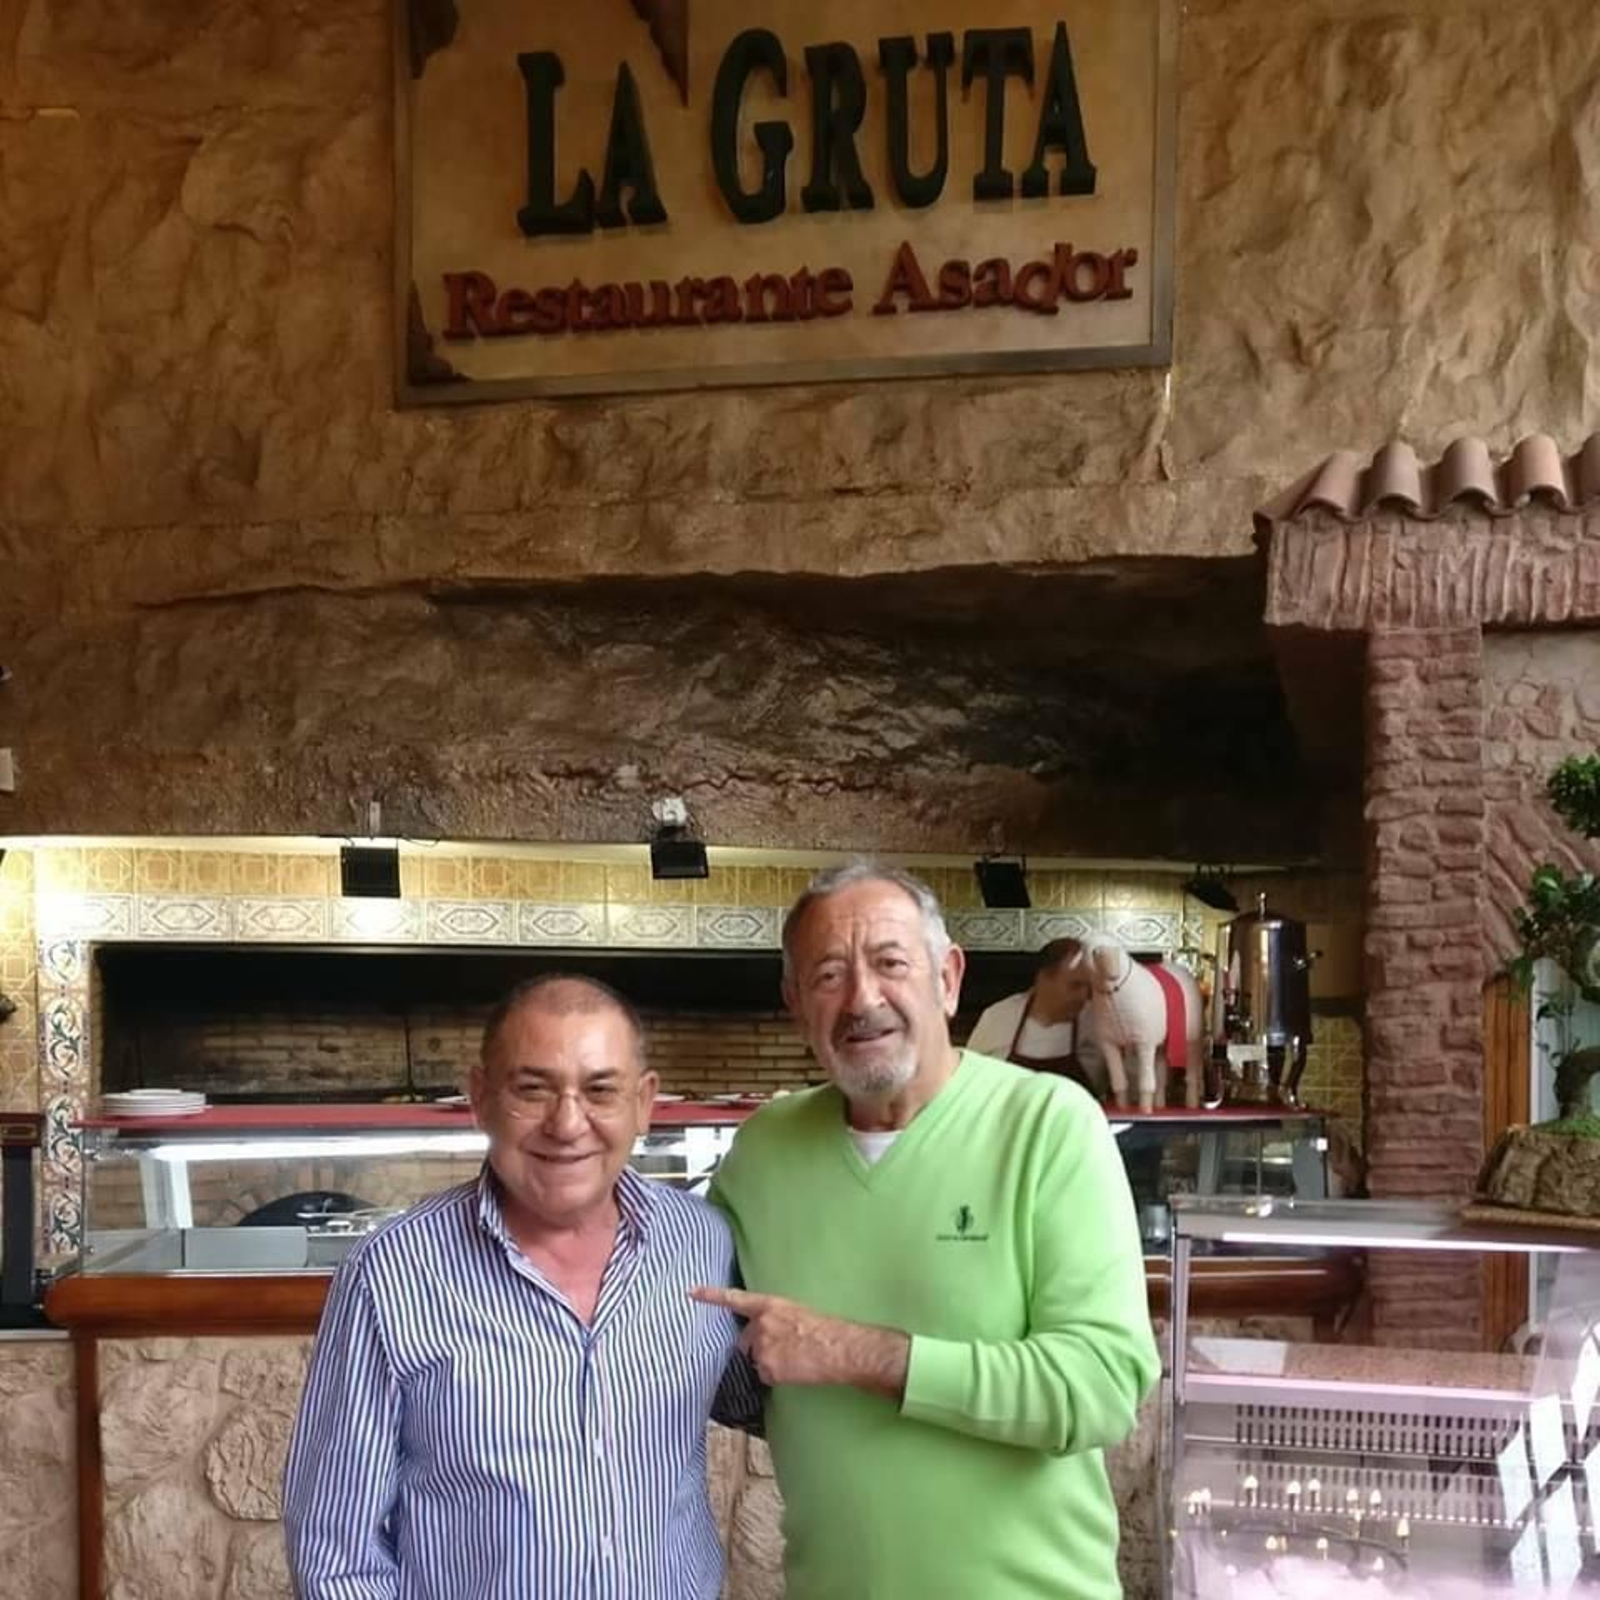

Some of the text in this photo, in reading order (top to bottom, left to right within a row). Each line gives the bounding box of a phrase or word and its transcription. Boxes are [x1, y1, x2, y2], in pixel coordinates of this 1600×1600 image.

[517, 20, 1097, 236] LA GRUTA
[442, 240, 1138, 340] Restaurante Asador
